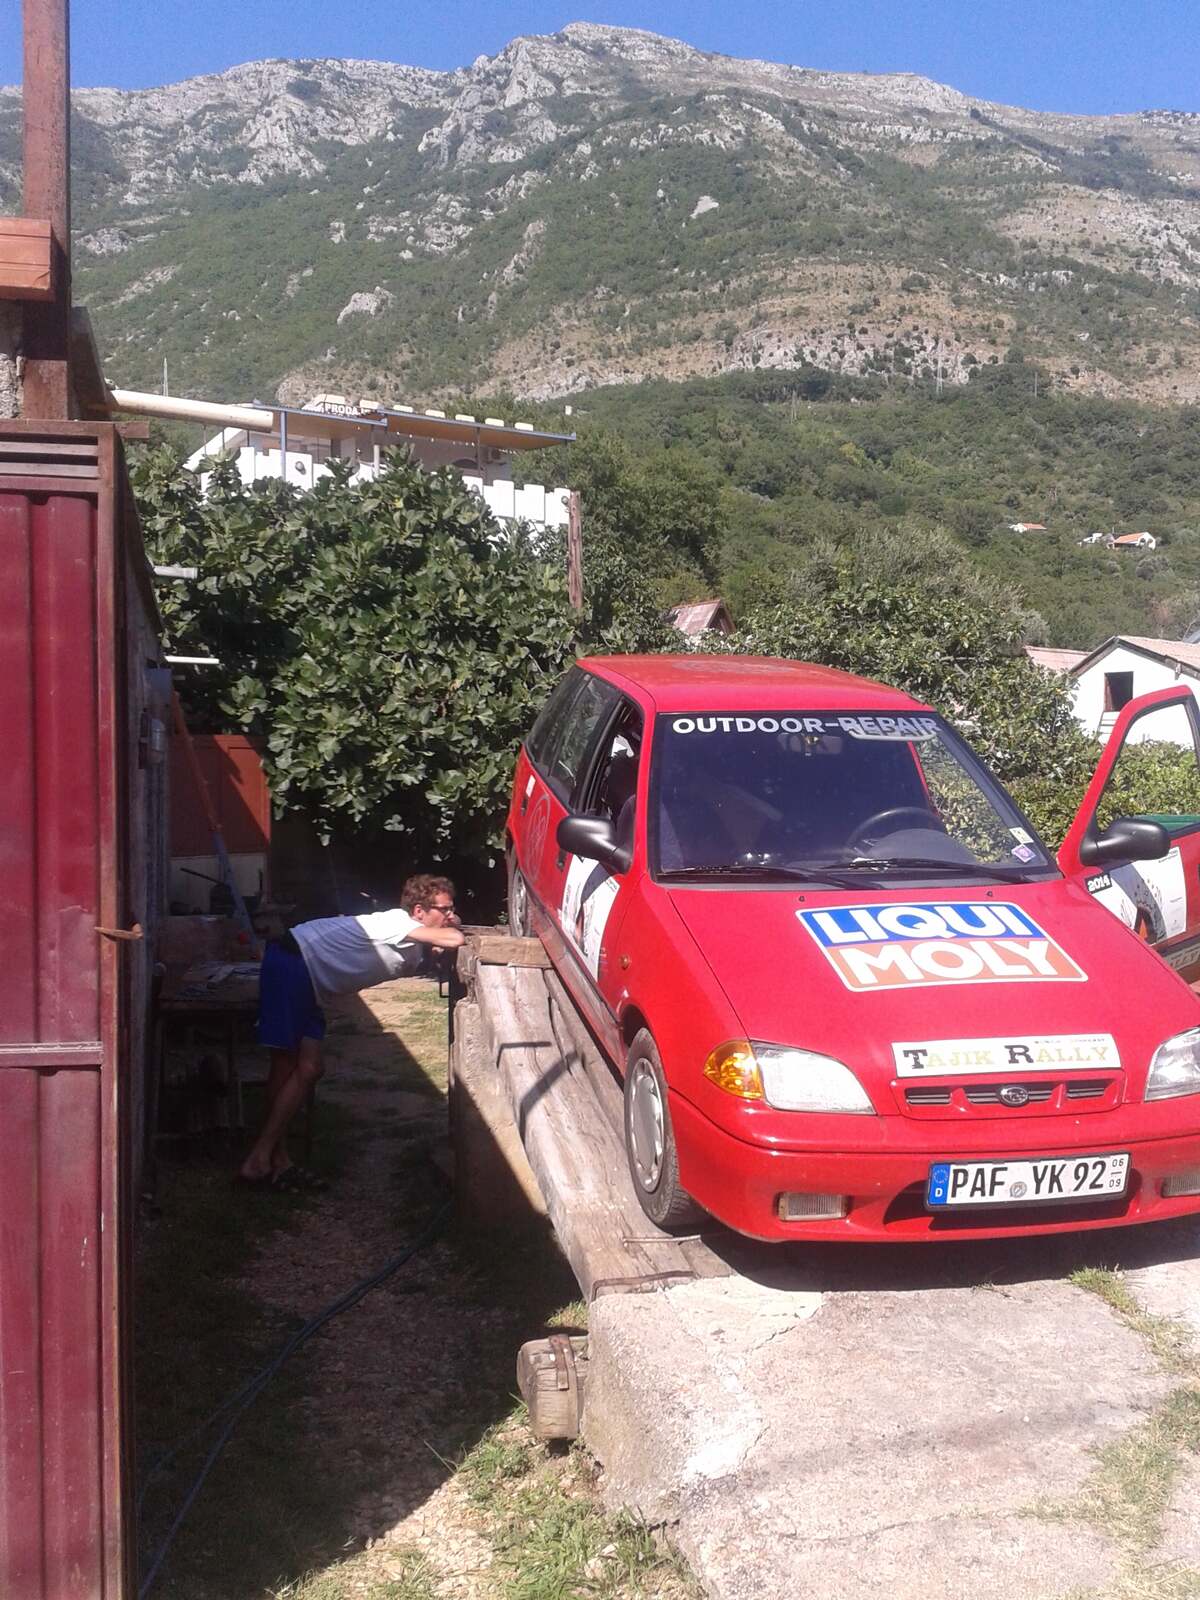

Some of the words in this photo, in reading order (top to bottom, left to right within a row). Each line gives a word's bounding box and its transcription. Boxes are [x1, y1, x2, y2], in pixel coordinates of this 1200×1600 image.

[672, 717, 941, 736] OUTDOOR-REPAIR
[1087, 874, 1111, 892] 2014
[812, 906, 1033, 944] LIQUI
[839, 941, 1058, 985] MOLY
[903, 1048, 995, 1070] TAJIK
[1004, 1044, 1109, 1065] RALLY
[951, 1166, 1008, 1198] PAF
[1032, 1163, 1066, 1195] YK
[1073, 1160, 1107, 1192] 92
[1109, 1178, 1121, 1188] 09
[935, 1187, 943, 1198] D
